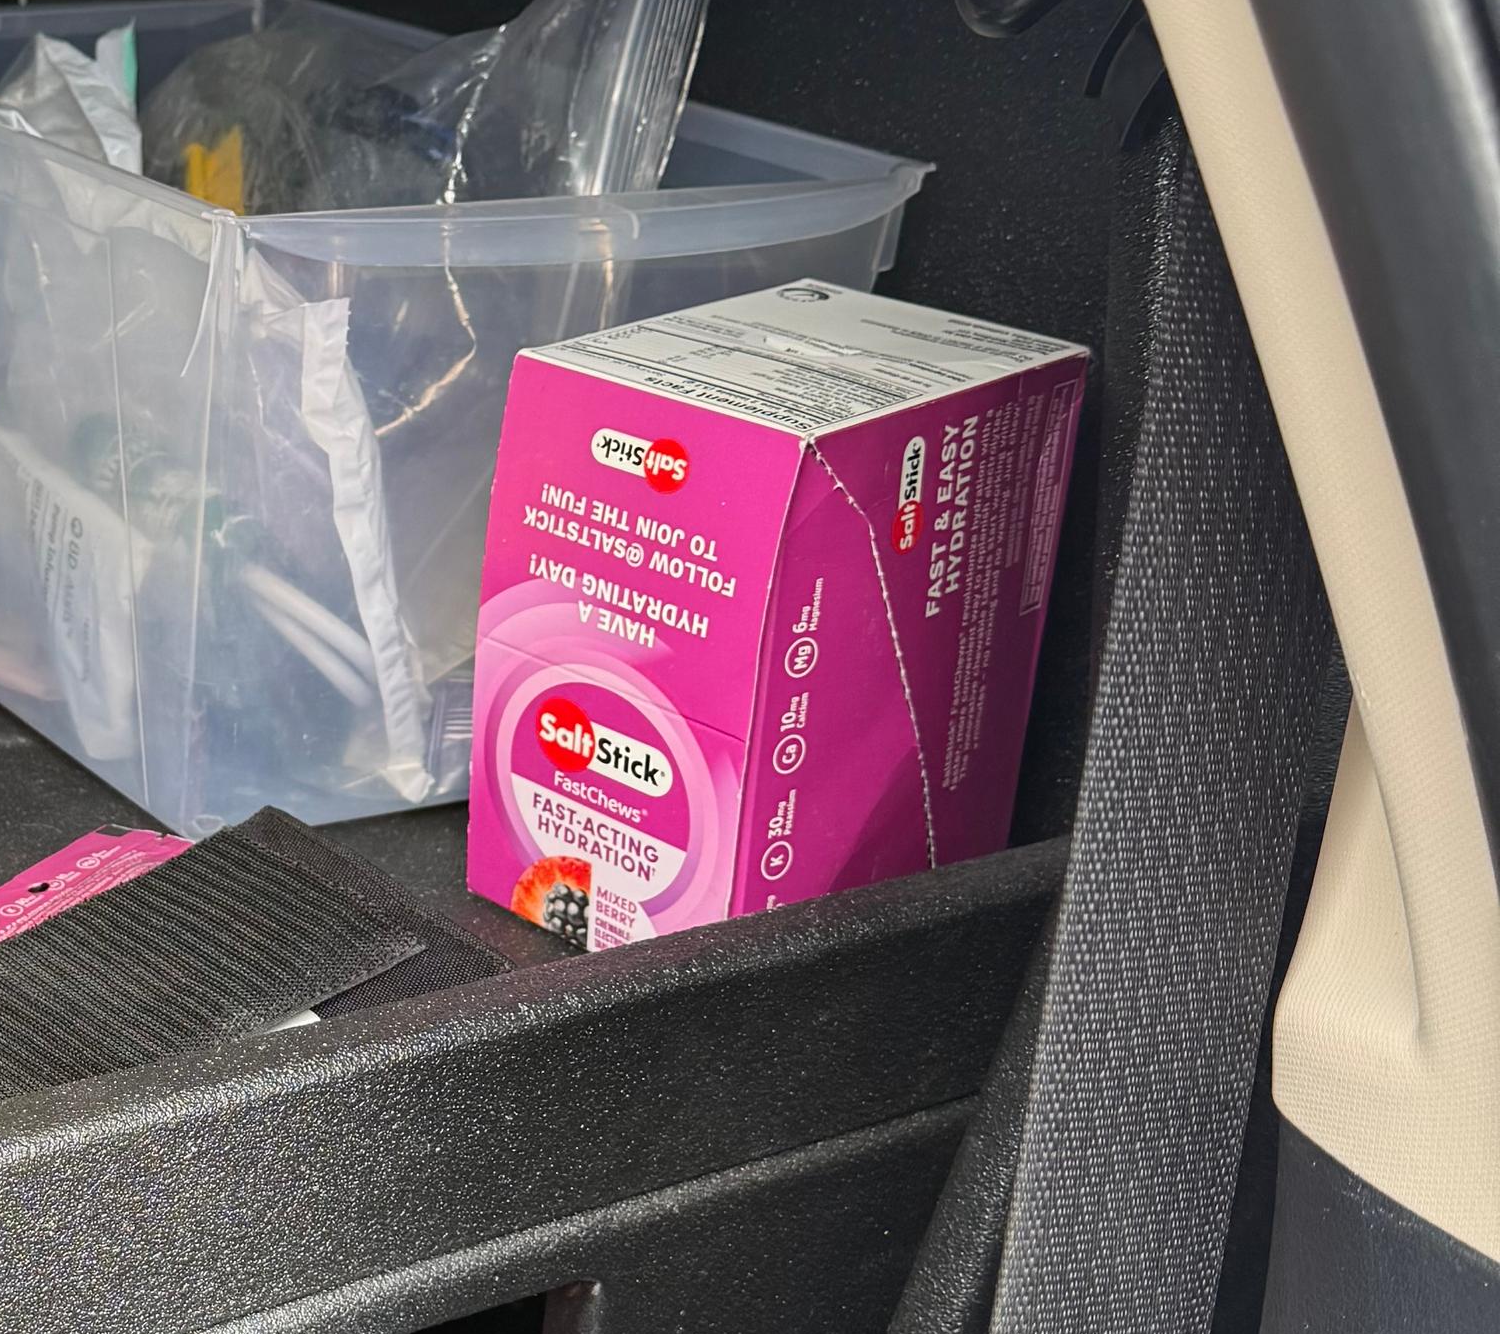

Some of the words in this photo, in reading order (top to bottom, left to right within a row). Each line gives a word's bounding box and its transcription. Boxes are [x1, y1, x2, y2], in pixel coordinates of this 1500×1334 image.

[643, 376, 694, 394] Facts
[697, 392, 812, 429] Supplement
[602, 435, 687, 480] SaltStick
[936, 424, 959, 502] EASY
[971, 459, 987, 530] hydration
[980, 421, 992, 454] with
[899, 444, 921, 550] SaltStick
[990, 451, 1006, 510] working
[541, 484, 586, 516] FUN!
[591, 500, 630, 531] THE
[945, 414, 978, 592] HYDRATION
[522, 505, 644, 568] @SALTSTICK
[636, 516, 684, 547] JOIN
[933, 509, 948, 531] &
[976, 502, 991, 569] replenish
[690, 535, 718, 561] TO
[528, 554, 576, 587] DAY!
[649, 551, 736, 597] FOLLOW
[925, 540, 945, 617] FAST
[579, 600, 592, 622] A
[582, 573, 709, 638] HYDRATING
[792, 605, 810, 632] 6mg
[809, 577, 823, 630] Magnesium
[597, 608, 655, 648] HAVE
[792, 646, 811, 669] Mg
[780, 696, 799, 731] 10mg
[796, 692, 809, 727] Calcium
[538, 708, 661, 787] SaltStick
[781, 744, 797, 763] Ca
[553, 768, 642, 824] FastChews
[784, 789, 796, 834] Potassium
[531, 791, 659, 865] FAST-ACTING
[768, 801, 786, 838] 30mg
[769, 855, 783, 867] K
[594, 899, 635, 928] BERRY
[596, 886, 637, 914] MIXED
